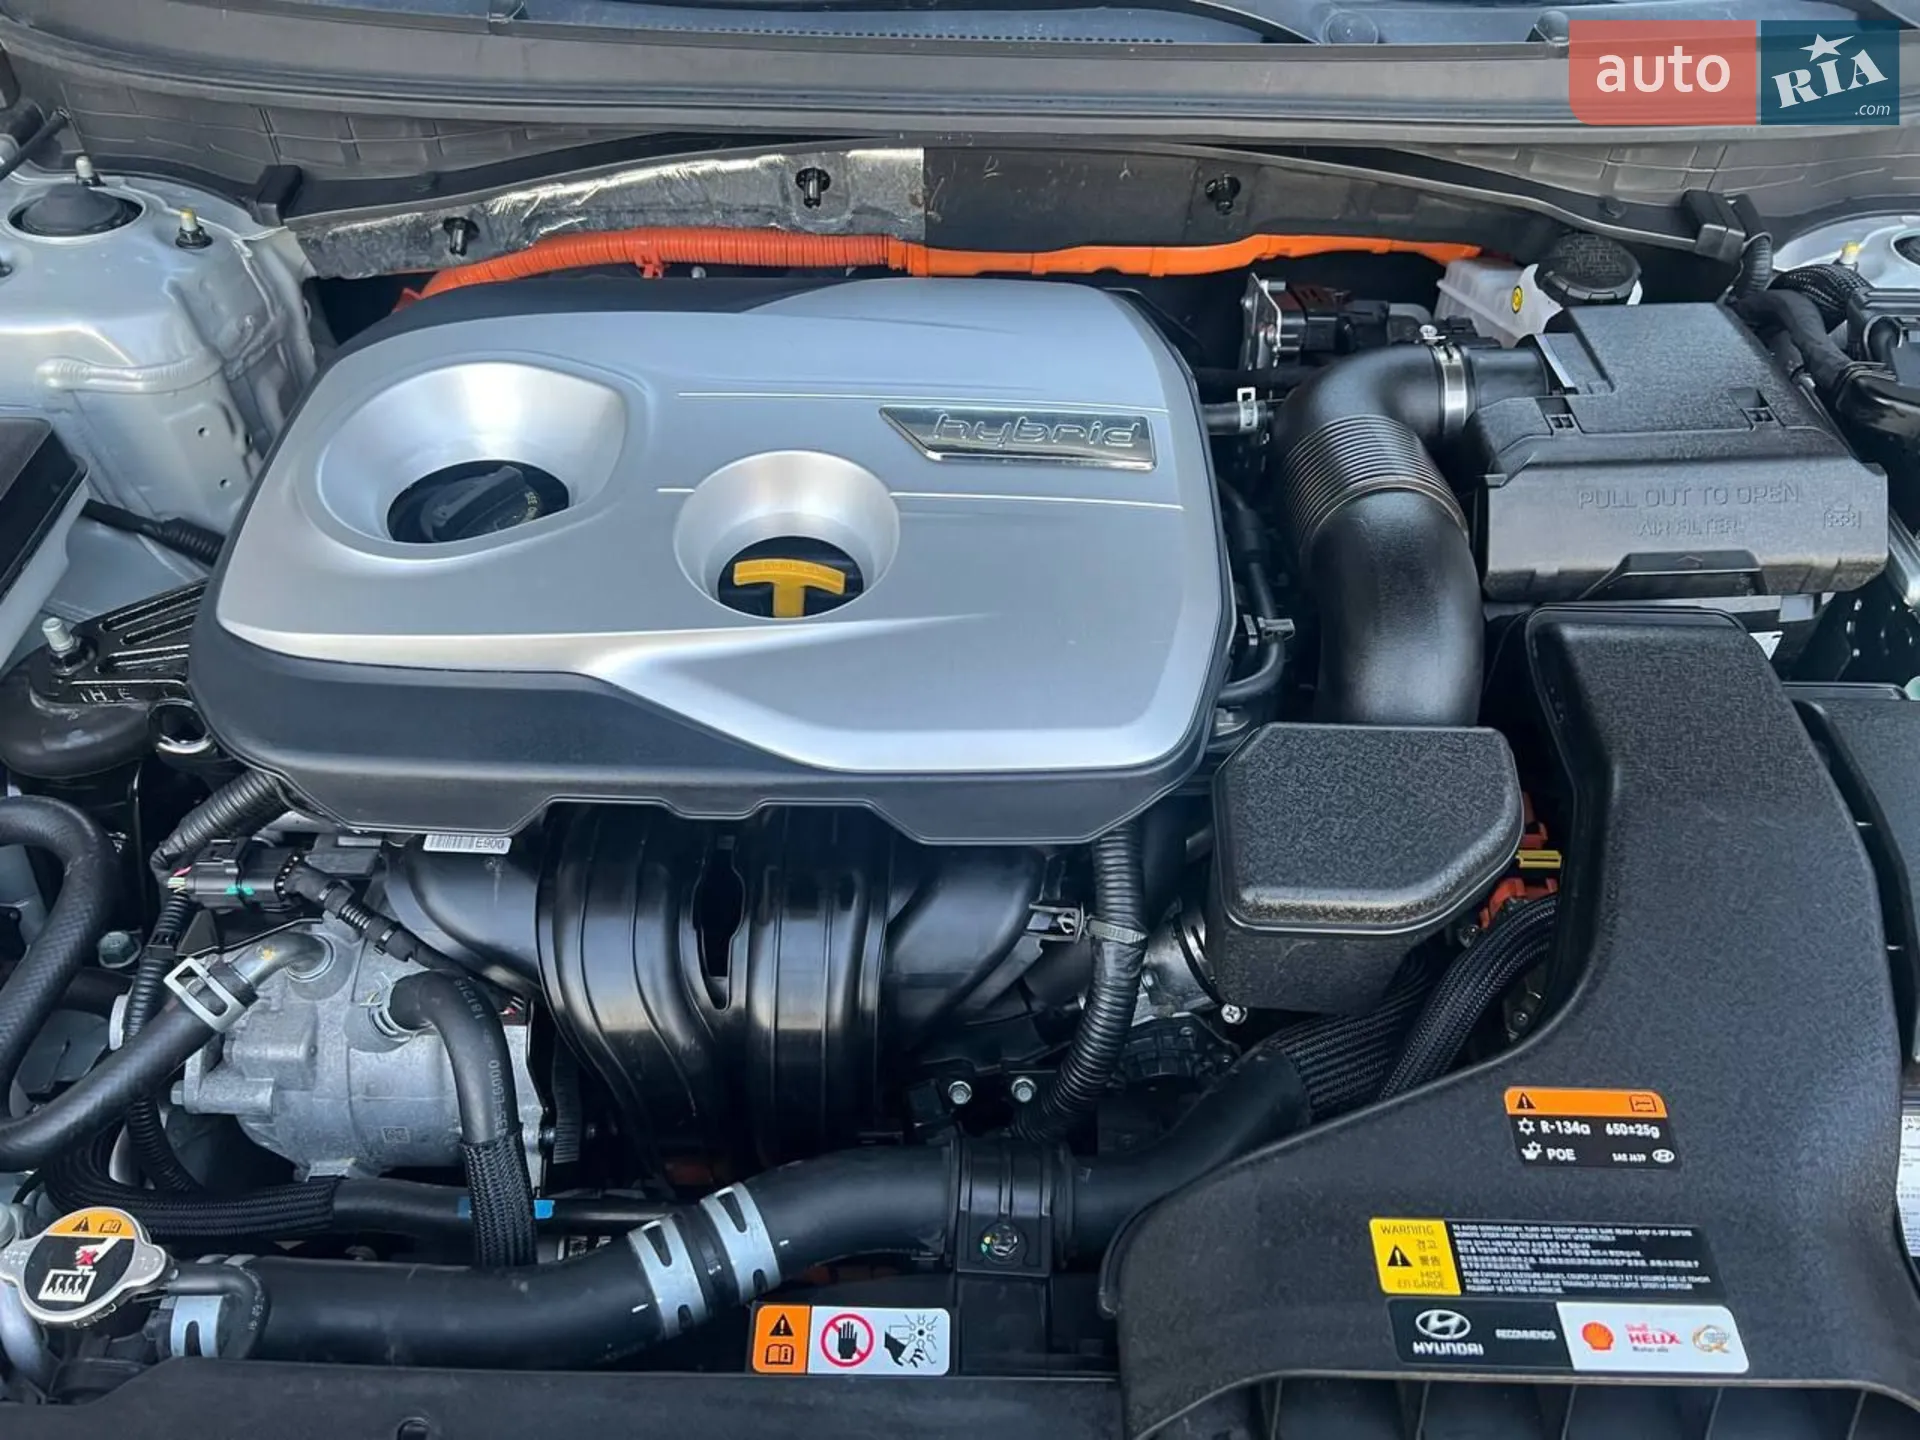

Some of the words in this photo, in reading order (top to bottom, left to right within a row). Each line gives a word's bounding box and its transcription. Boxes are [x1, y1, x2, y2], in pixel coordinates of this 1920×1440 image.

[932, 413, 1140, 448] hybrid
[1578, 488, 1637, 509] PULL
[1645, 487, 1691, 508] OUT
[1699, 486, 1729, 506] TO
[1737, 483, 1799, 504] OPEN
[1638, 519, 1671, 537] AIR
[1676, 518, 1739, 536] FILTER
[1540, 1120, 1591, 1136] R-134a
[1546, 1148, 1577, 1161] POE
[1380, 1224, 1435, 1236] WARNING
[1628, 1333, 1683, 1345] HELIX
[1412, 1341, 1485, 1356] HYUNDAI
